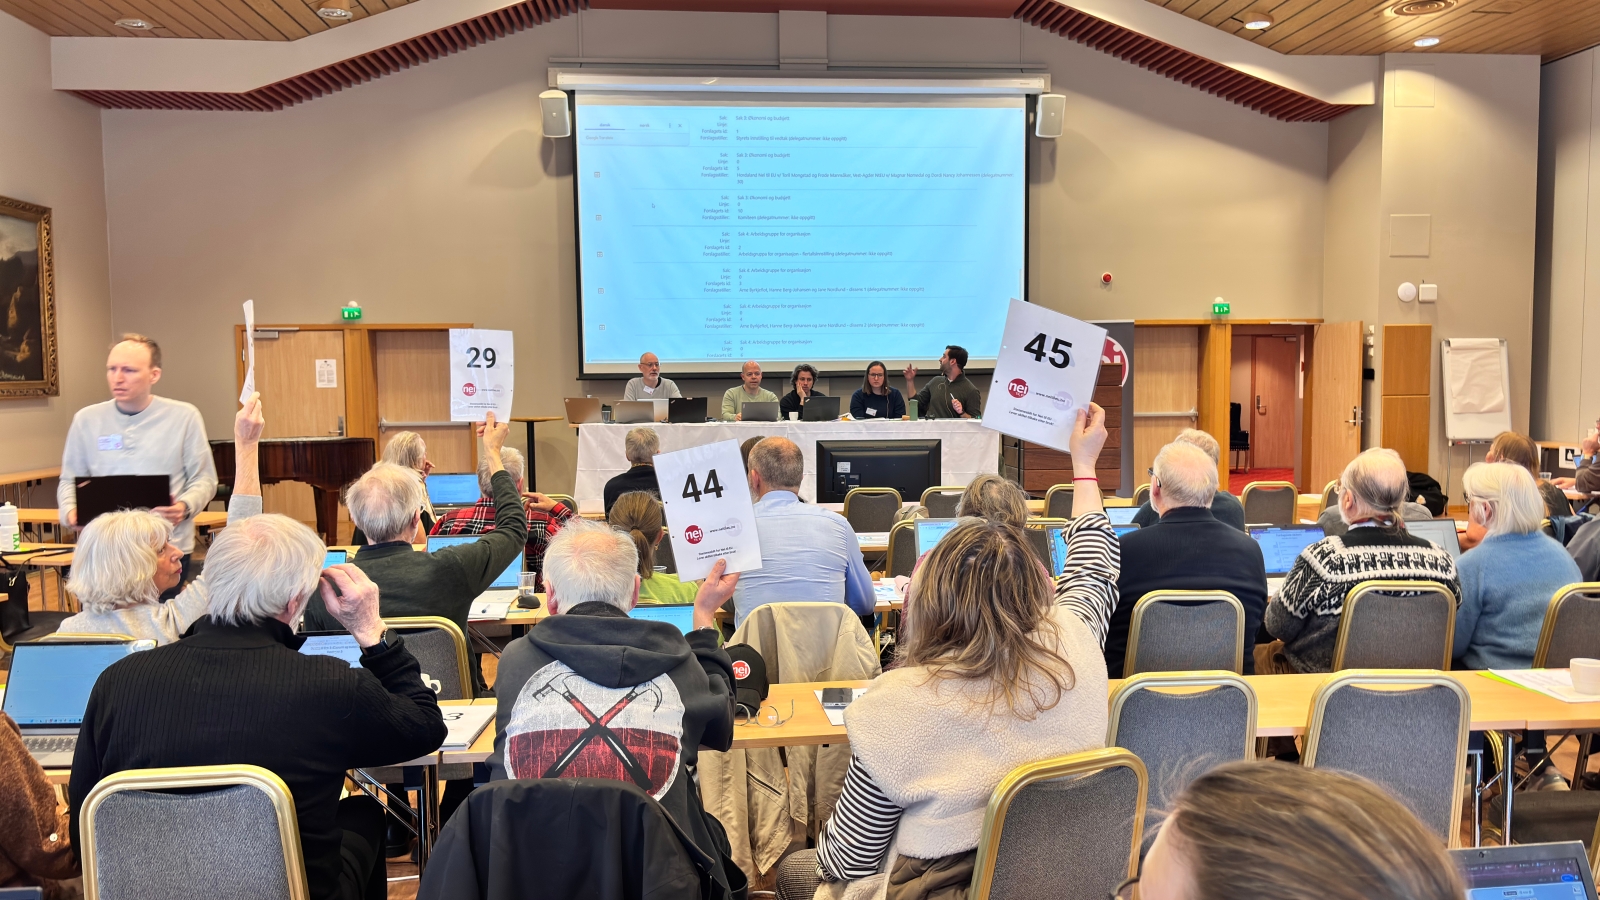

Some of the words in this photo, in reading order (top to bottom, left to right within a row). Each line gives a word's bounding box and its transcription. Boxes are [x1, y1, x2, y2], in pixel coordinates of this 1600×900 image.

[466, 347, 496, 368] 29
[1024, 332, 1072, 369] 45
[1009, 382, 1028, 395] nei
[682, 468, 724, 503] 44
[686, 528, 702, 540] nei
[733, 664, 748, 675] nei
